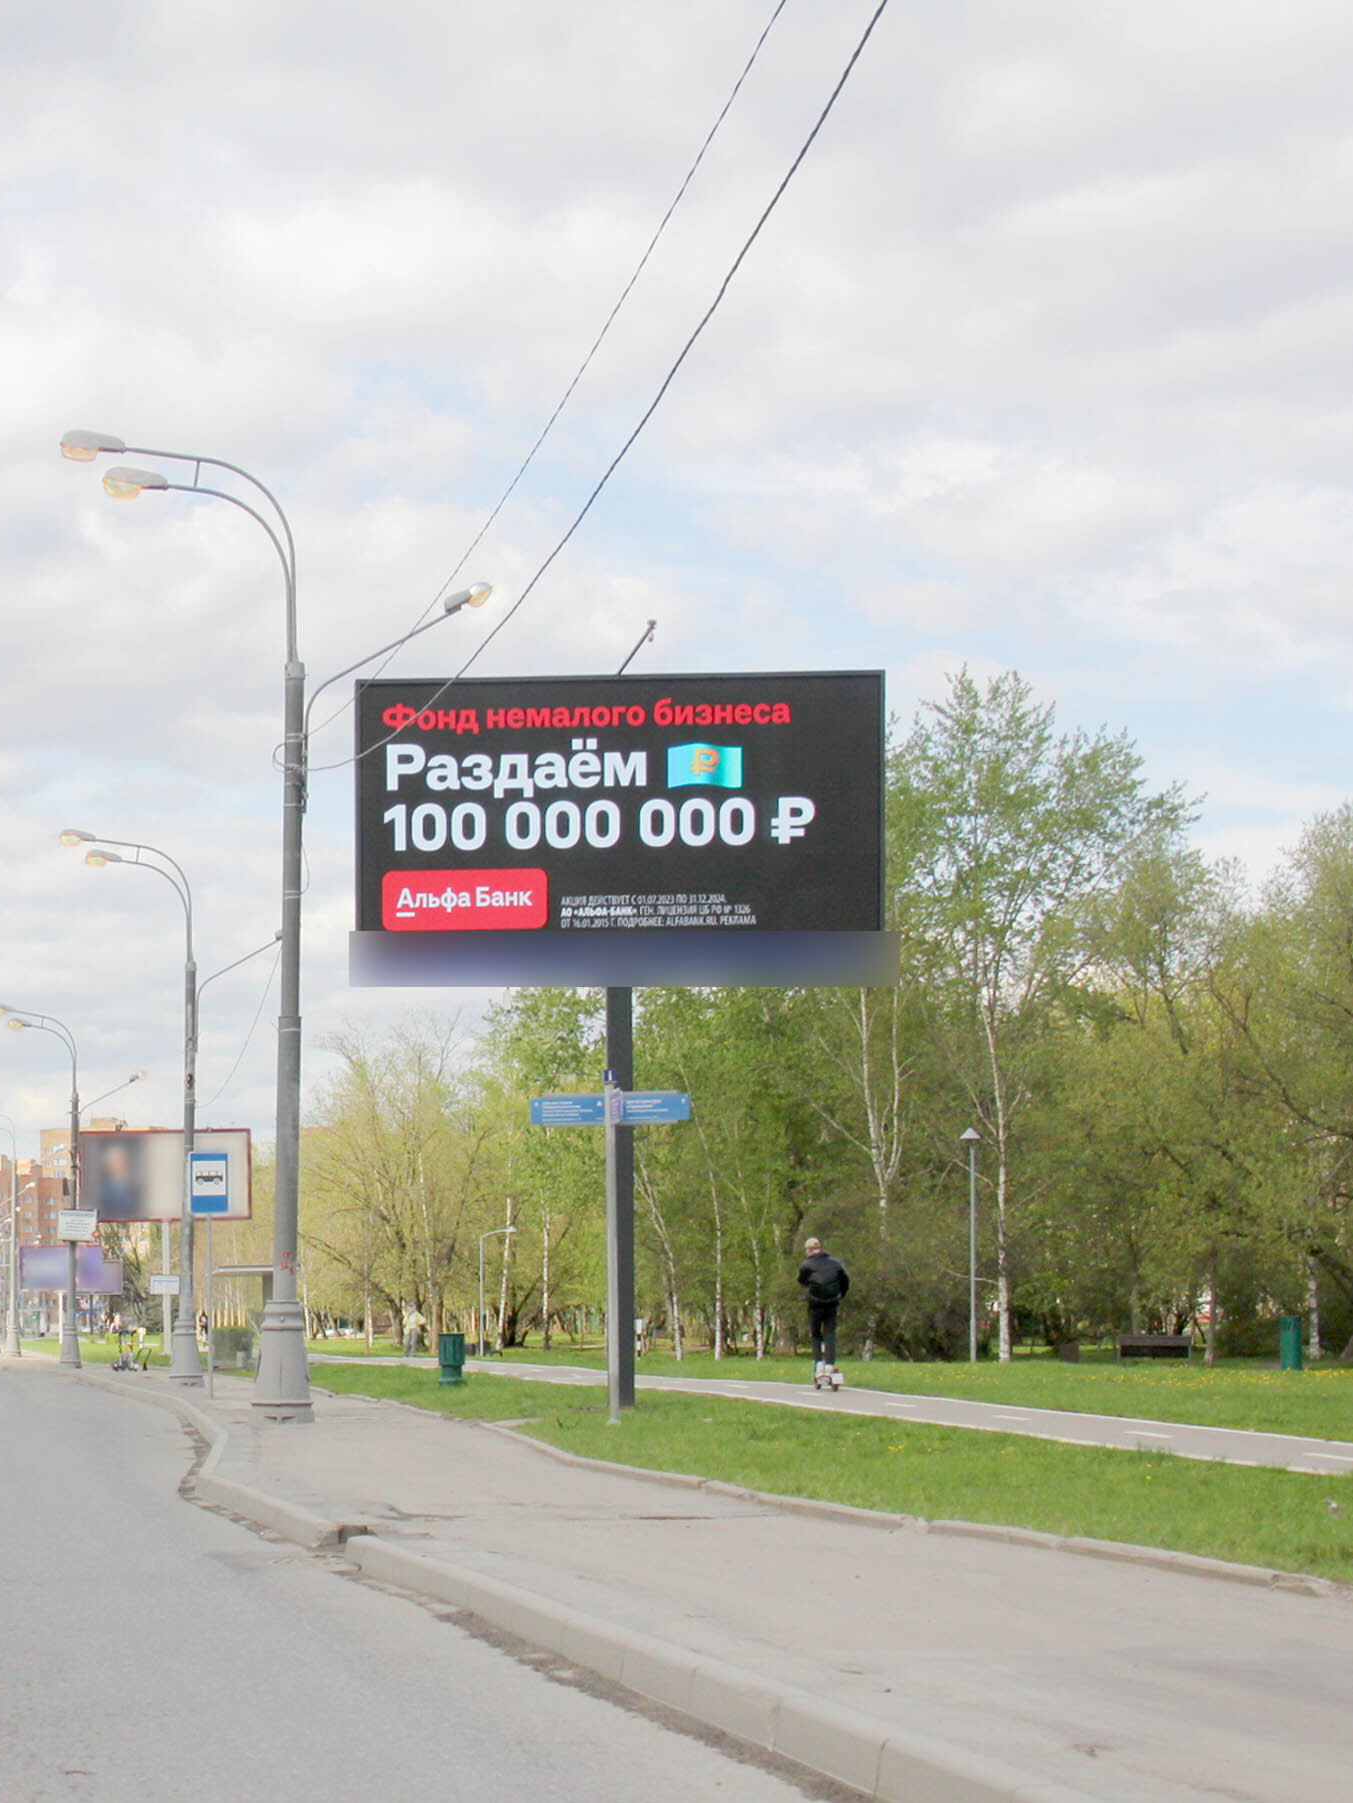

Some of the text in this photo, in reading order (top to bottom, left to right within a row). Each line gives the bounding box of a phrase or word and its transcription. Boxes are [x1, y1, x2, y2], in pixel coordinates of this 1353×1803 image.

[382, 697, 792, 735] Фонд немалого бизнеса
[386, 738, 647, 798] Раздаём
[383, 802, 486, 852] 100
[505, 800, 621, 849] 000
[639, 797, 755, 847] 000
[396, 886, 533, 913] Альфа Банк
[560, 907, 572, 917] АО
[560, 919, 570, 929] ОТ
